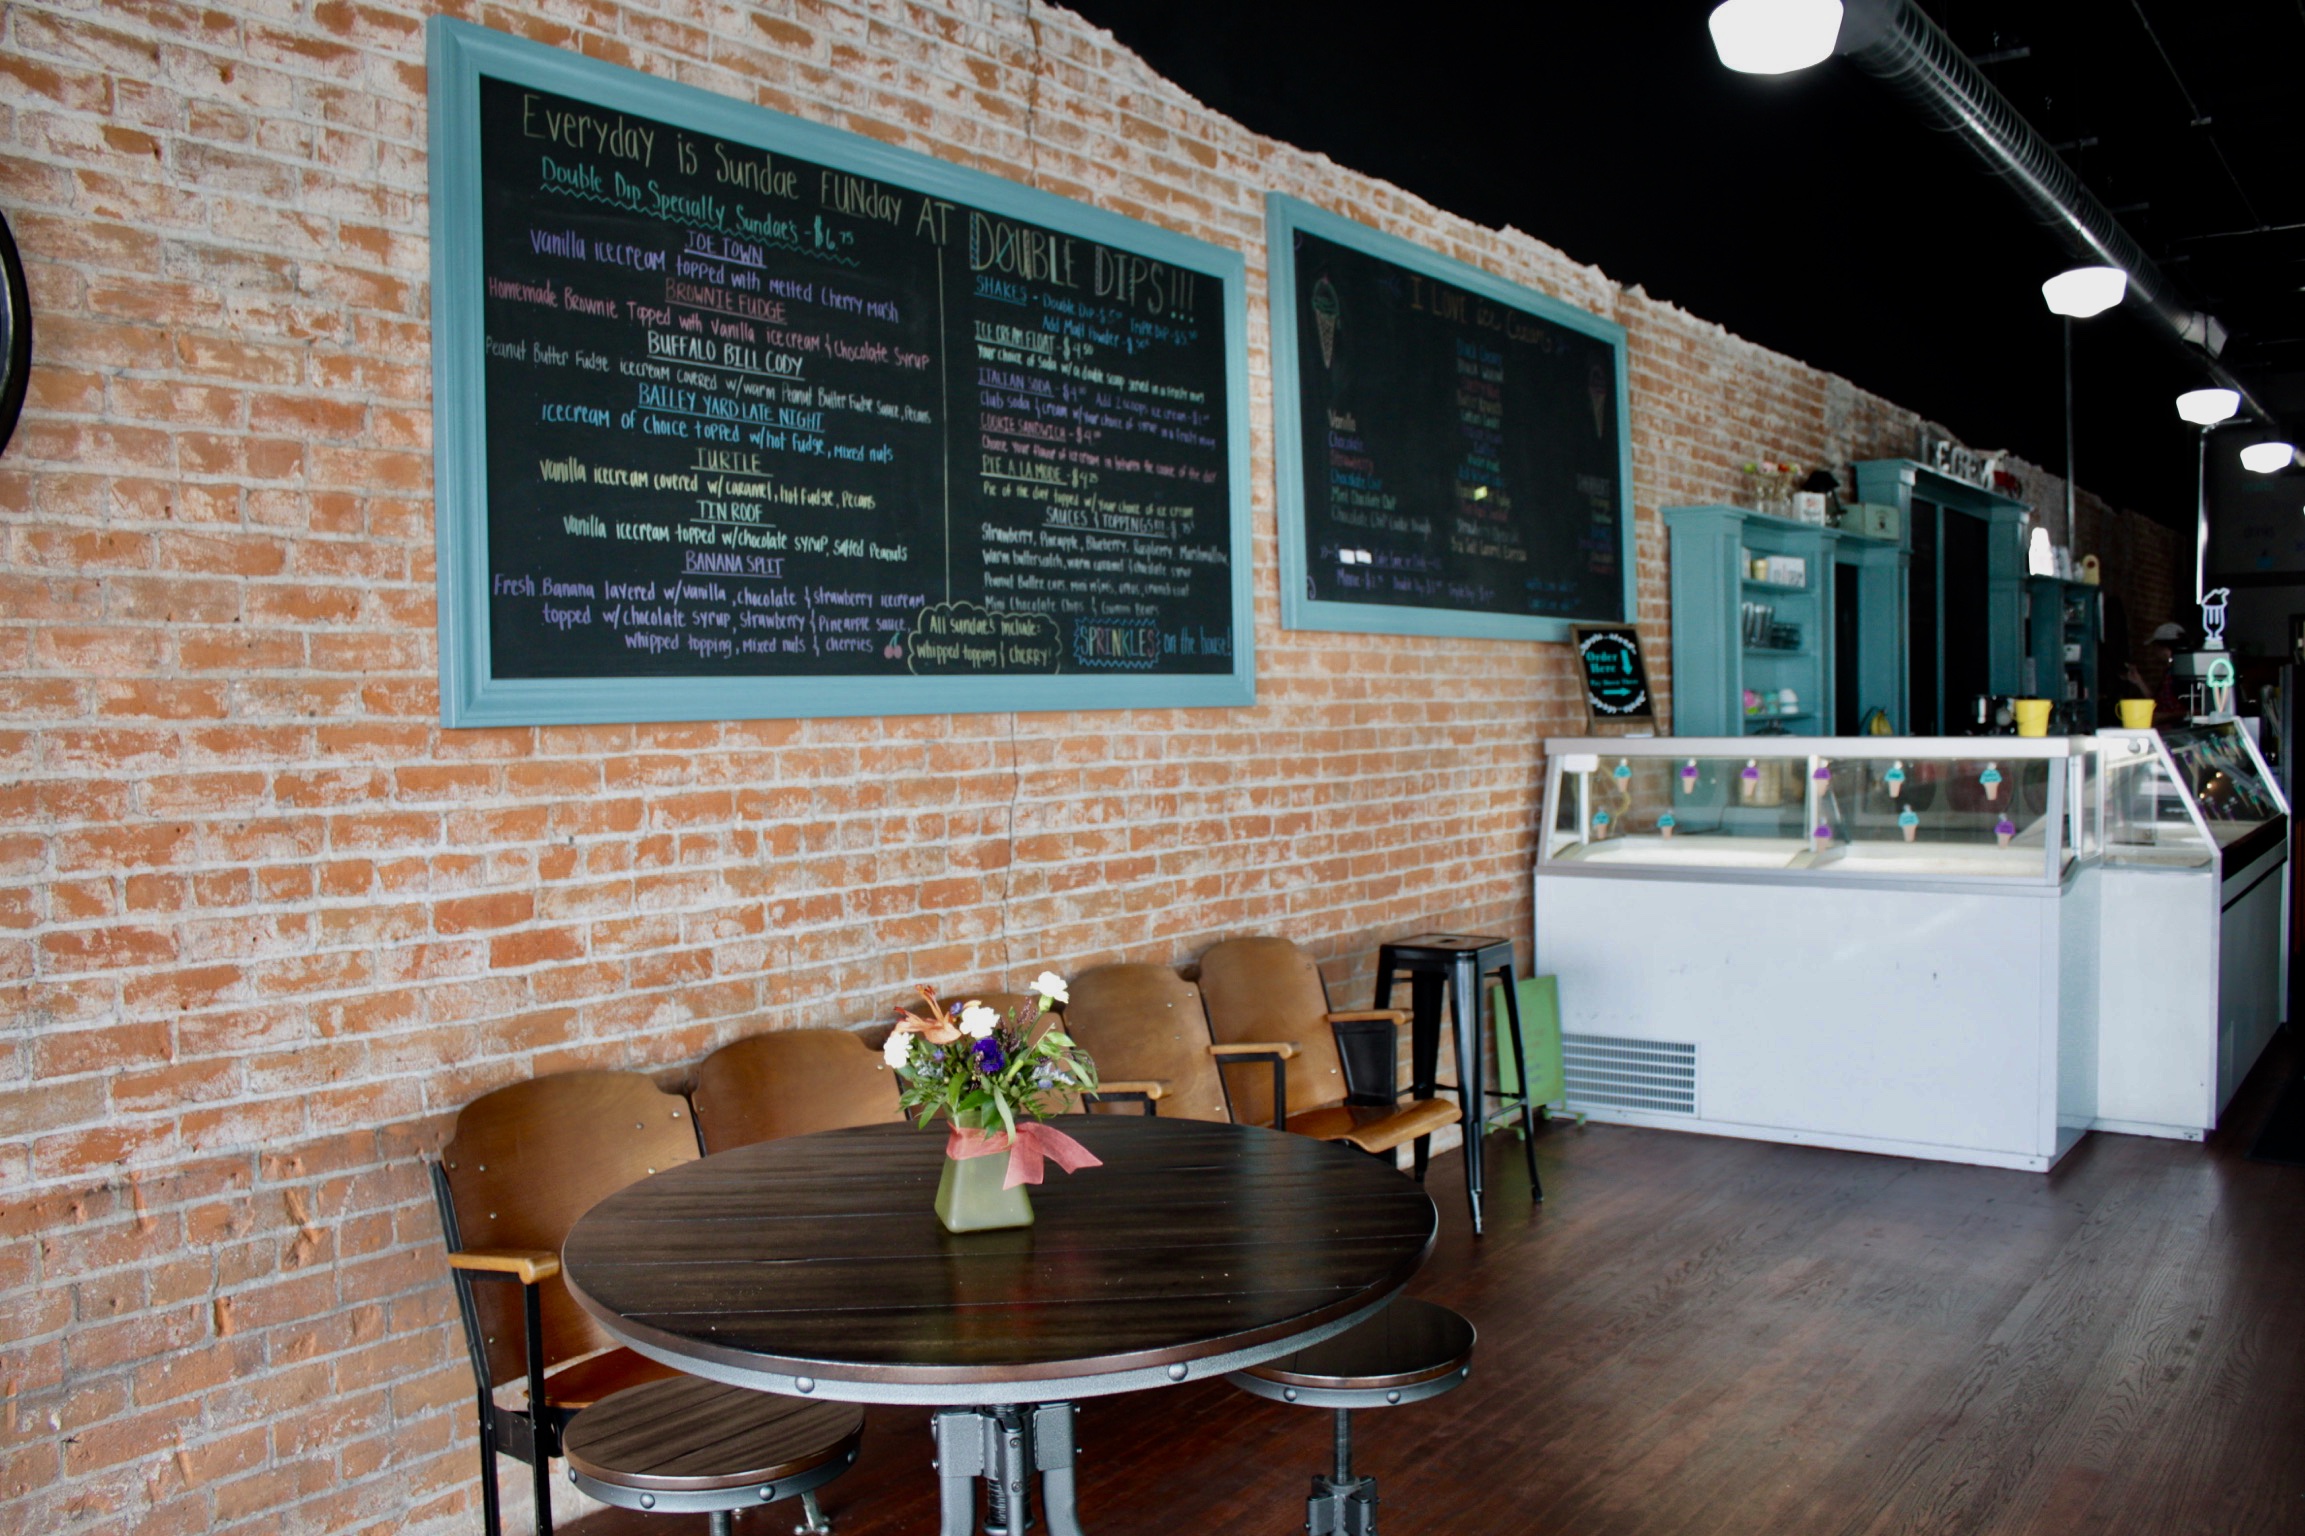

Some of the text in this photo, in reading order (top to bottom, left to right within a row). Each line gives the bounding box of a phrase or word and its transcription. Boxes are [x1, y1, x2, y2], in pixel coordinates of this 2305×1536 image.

[524, 93, 654, 168] Everyday
[677, 132, 698, 176] is
[715, 142, 799, 200] Sundae
[821, 170, 902, 227] FUNday
[916, 197, 956, 246] AT
[970, 212, 1079, 289] DOUBLE
[542, 156, 604, 194] Double
[615, 171, 642, 207] Dip
[686, 230, 765, 267] JOE TOWN
[676, 254, 725, 285] topped
[731, 271, 761, 292] with
[489, 276, 559, 307] Homemade
[679, 313, 703, 334] with
[665, 277, 786, 320] BROWNIE FUDGE
[974, 275, 1029, 304] SHAKES
[486, 335, 526, 360] Peanut
[533, 342, 568, 367] Butter
[575, 350, 610, 372] Fudge
[648, 330, 803, 376] BUFFALO BILL CODY
[974, 319, 993, 344] ICE
[1025, 330, 1056, 356] FLOAT
[977, 366, 1025, 392] ITALIAN
[638, 382, 825, 433] BAILEY YARD LATE NIGHT
[620, 409, 637, 429] of
[693, 421, 740, 443] topped
[868, 444, 894, 465] nuts
[694, 446, 762, 475] TURTLE
[695, 499, 764, 524] TIN ROOF
[1045, 505, 1089, 529] SAUCES
[674, 522, 716, 545] topped
[685, 549, 785, 577] BANANA SPLIT
[493, 572, 535, 598] Fresh
[541, 576, 596, 601] Banana
[604, 579, 656, 602] layered
[542, 602, 592, 631] topped
[929, 614, 947, 636] All
[624, 632, 681, 656] whipped
[782, 635, 807, 654] nuts
[916, 639, 960, 666] whipped
[962, 643, 998, 670] topping
[1079, 625, 1155, 659] SPRINKLES
[1162, 633, 1178, 656] on
[1180, 625, 1197, 657] the
